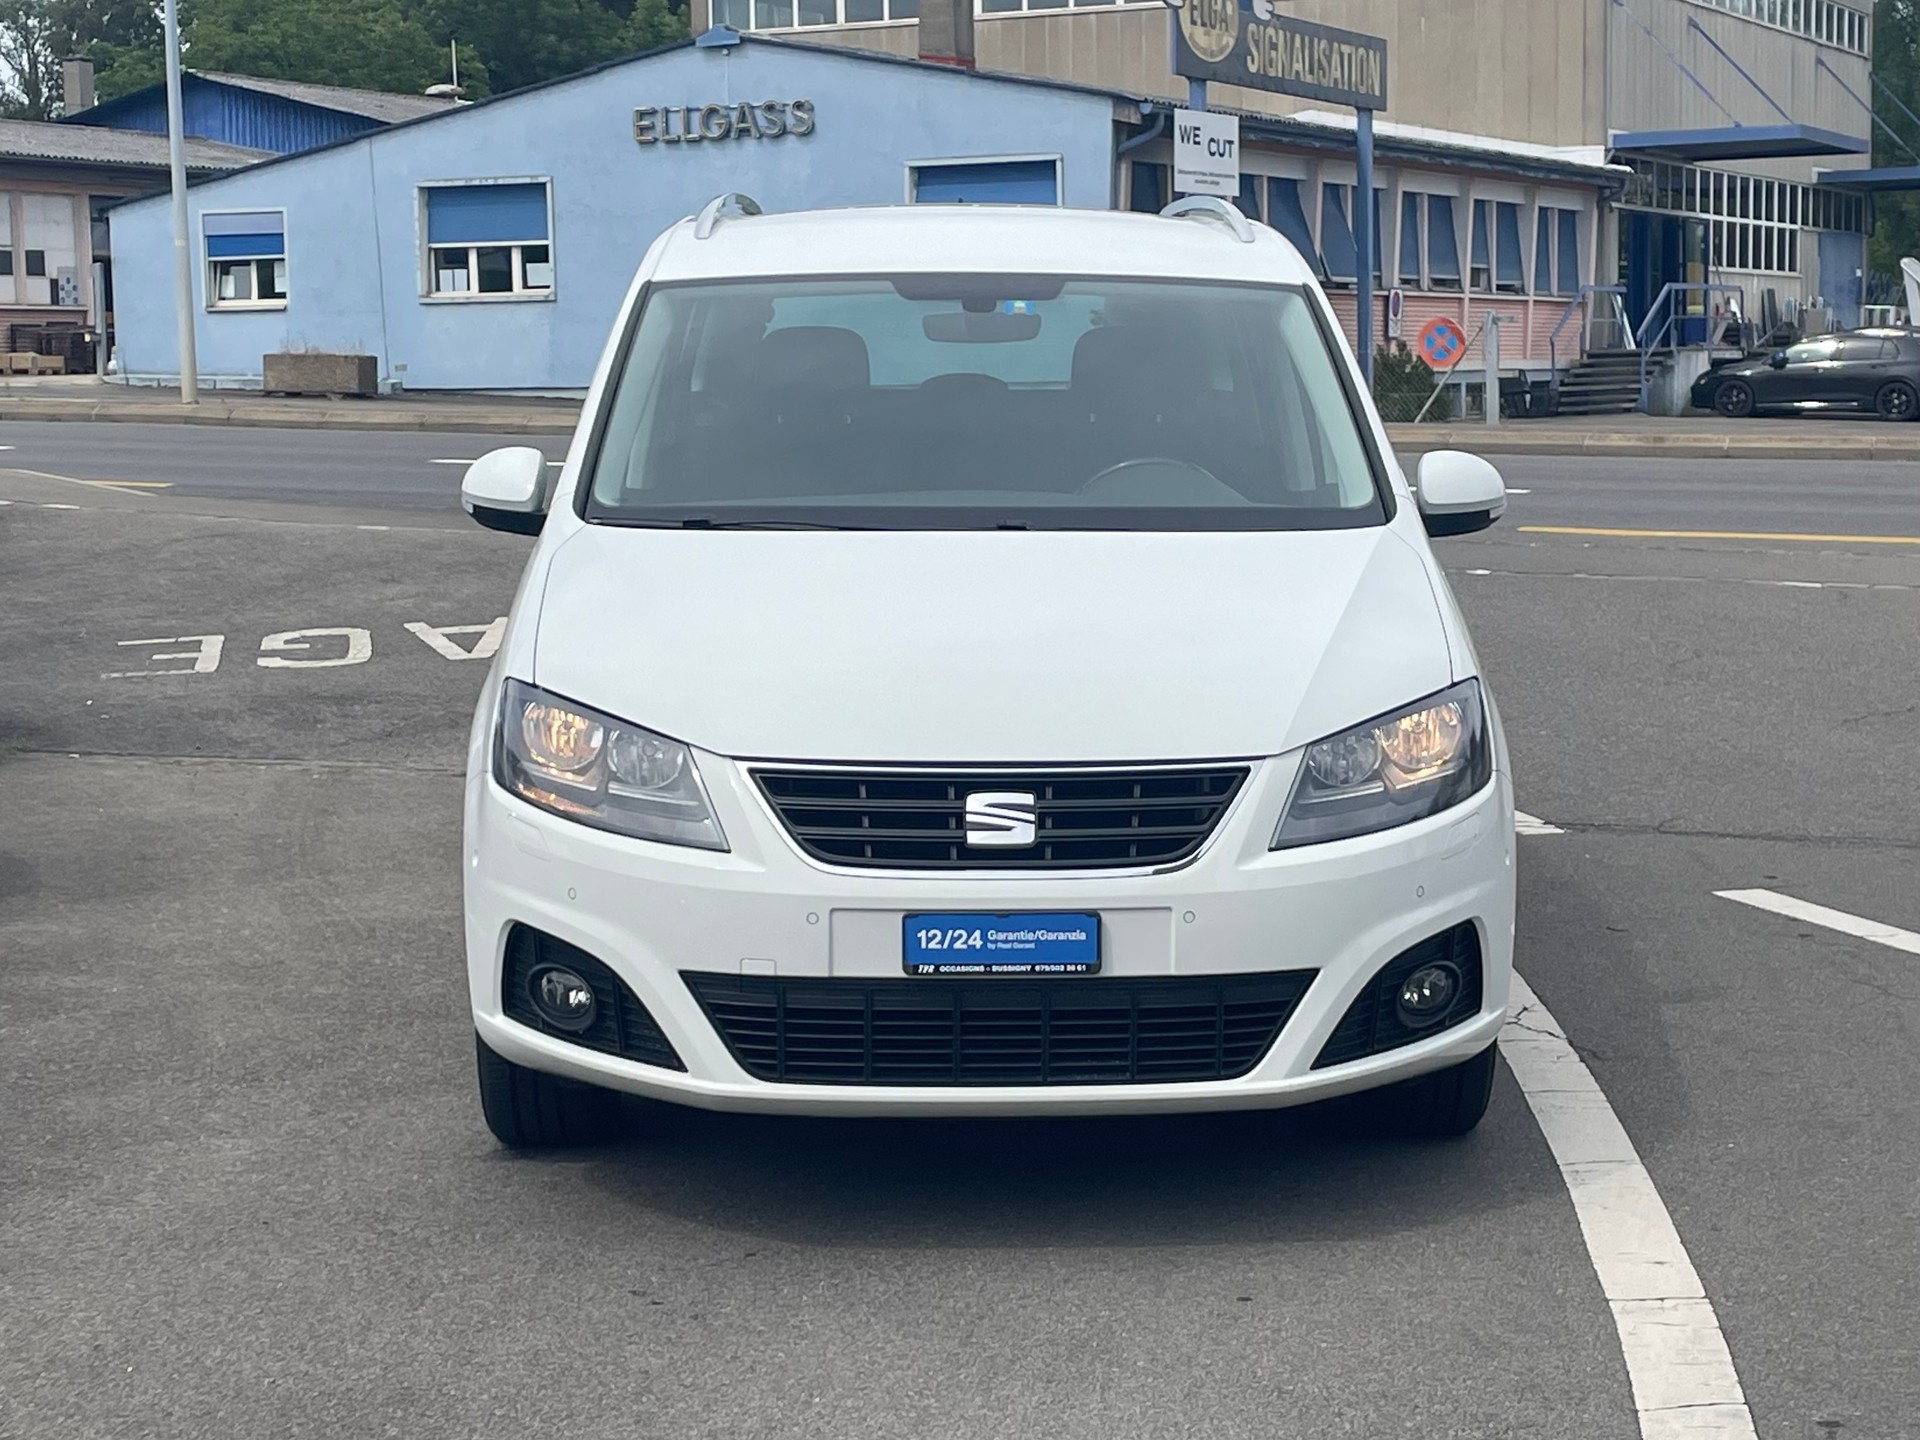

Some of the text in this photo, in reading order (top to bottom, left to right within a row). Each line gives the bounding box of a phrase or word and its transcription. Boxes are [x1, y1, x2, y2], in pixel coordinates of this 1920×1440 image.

[1246, 22, 1382, 97] SIGNALISATION
[632, 99, 815, 144] ELLGASS
[1178, 124, 1235, 159] WE CUT
[100, 616, 509, 680] AGE
[916, 929, 984, 950] 12/24
[987, 929, 1087, 942] Garantie/Garanzia
[939, 965, 985, 973] OCCASIONS
